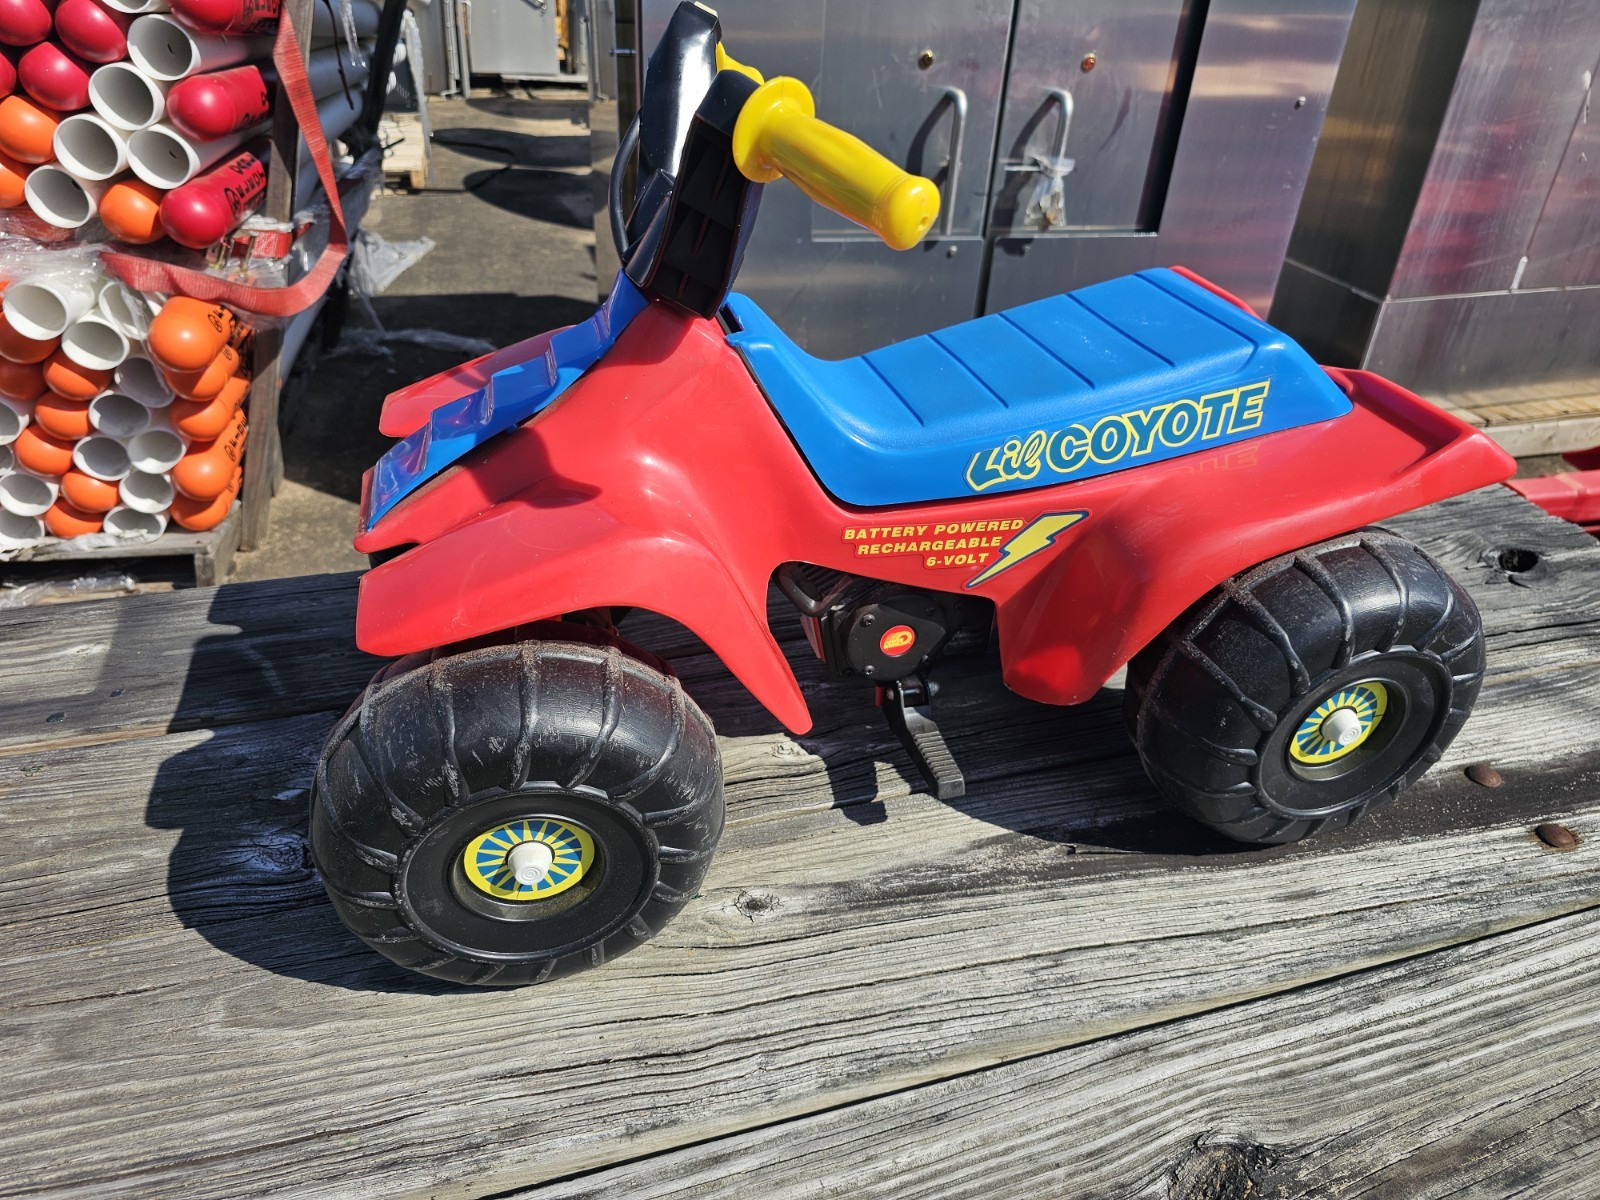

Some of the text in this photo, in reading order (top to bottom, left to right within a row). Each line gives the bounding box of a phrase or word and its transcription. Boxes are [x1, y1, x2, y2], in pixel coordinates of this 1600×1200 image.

[966, 429, 1047, 491] Lil
[1045, 379, 1271, 473] COYOTE
[843, 519, 1024, 540] BATTERY POWERED
[857, 536, 1003, 555] RECHARGEABLE
[926, 552, 990, 567] 6-VOLT
